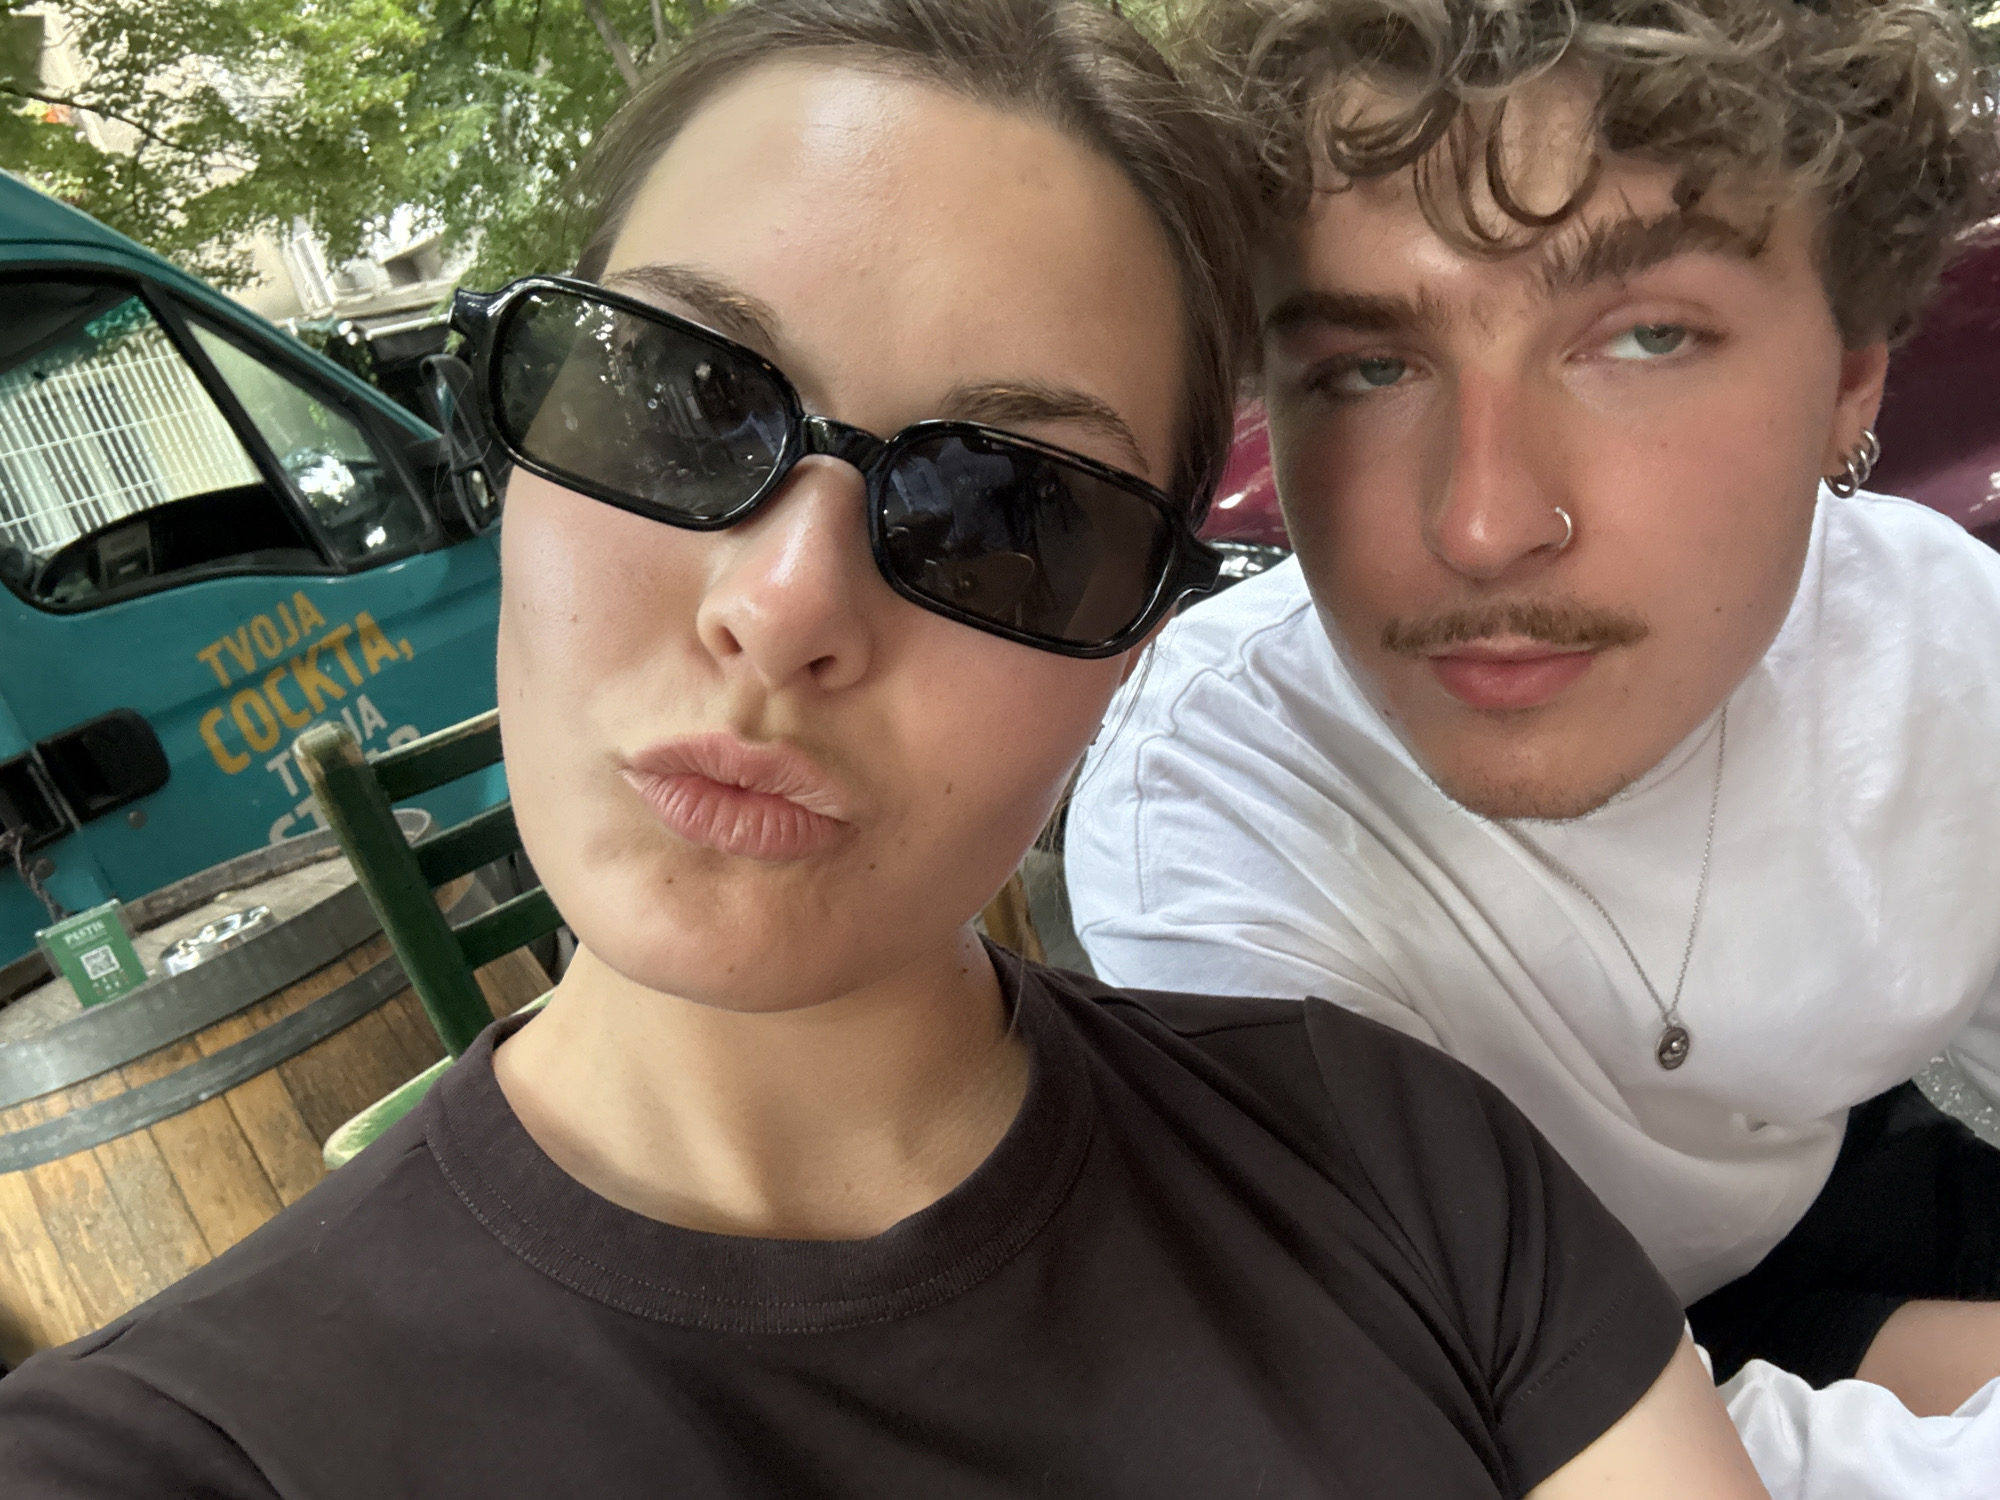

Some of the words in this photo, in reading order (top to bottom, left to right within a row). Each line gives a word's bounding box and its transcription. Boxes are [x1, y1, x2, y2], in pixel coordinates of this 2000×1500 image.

[197, 590, 326, 688] TVOJA
[199, 611, 414, 774] COCKTA,
[266, 694, 387, 797] TJA
